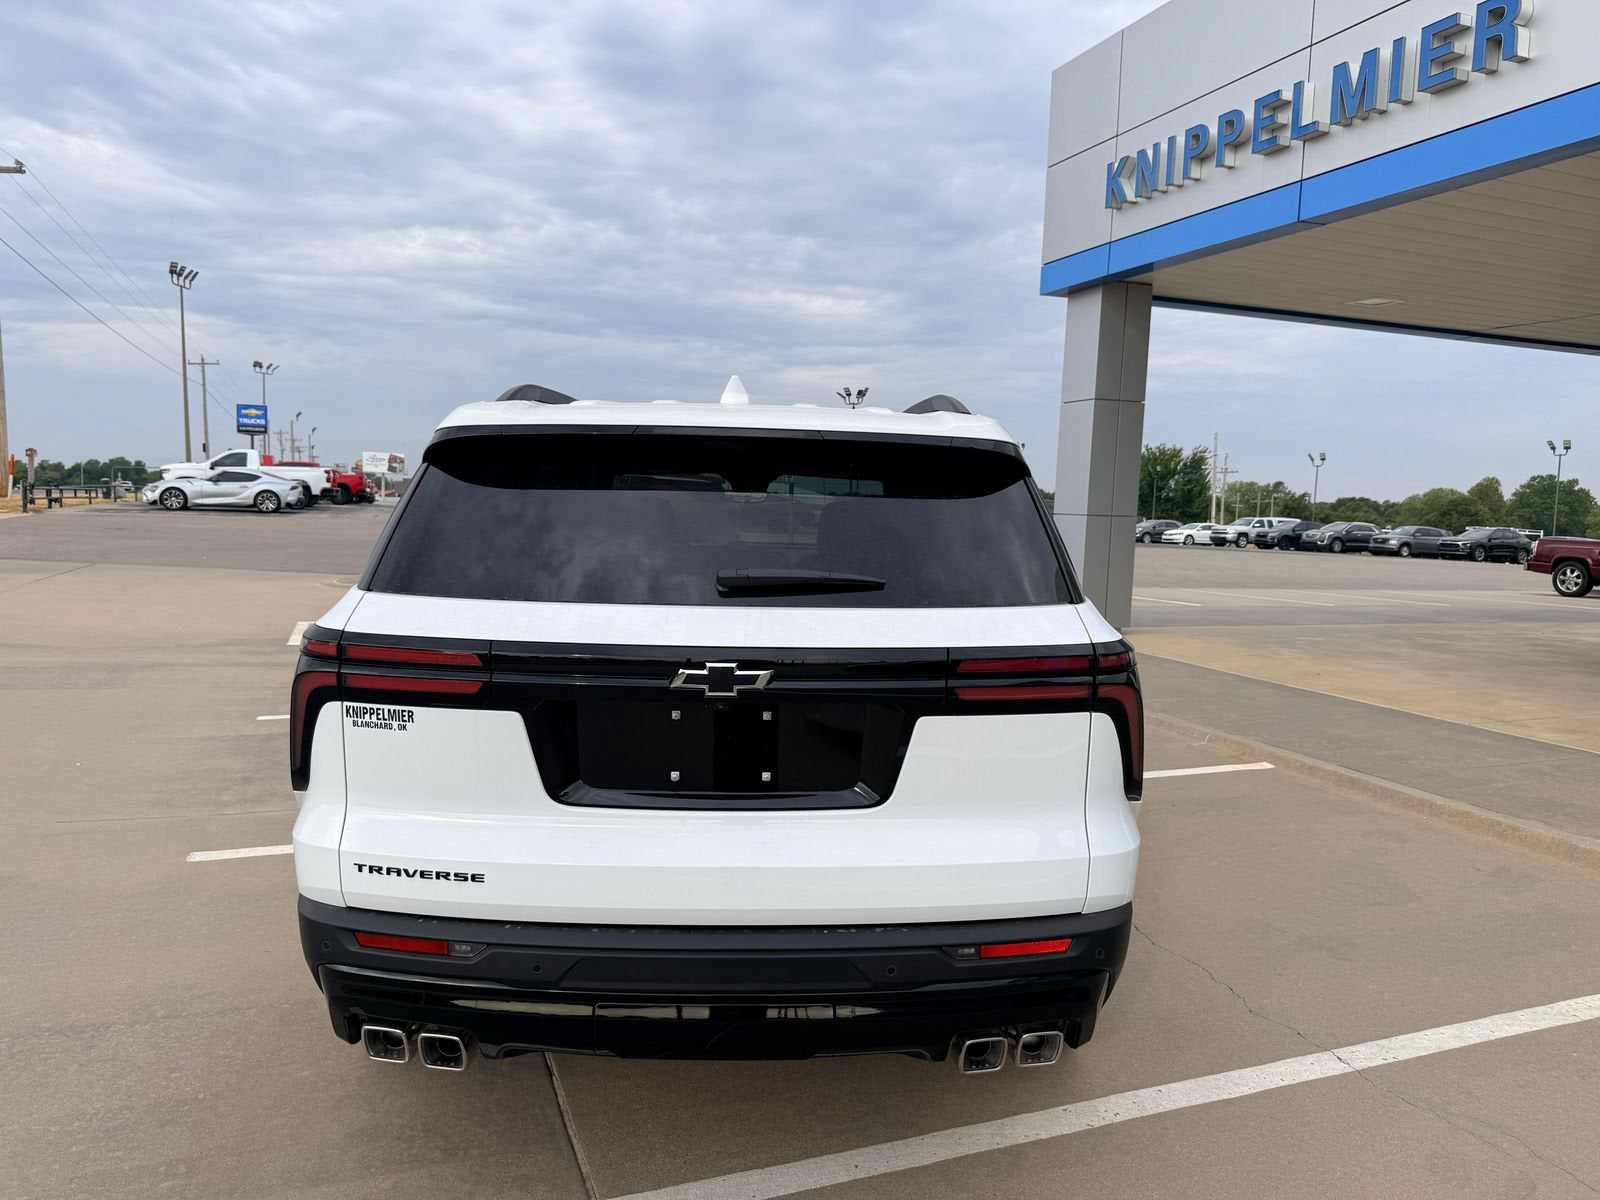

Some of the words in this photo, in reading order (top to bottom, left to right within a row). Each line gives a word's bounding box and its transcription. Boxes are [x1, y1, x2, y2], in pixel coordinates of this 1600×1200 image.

[1105, 0, 1531, 210] KNIPPELMIER
[239, 417, 266, 425] TRUCKS
[345, 704, 415, 724] KNIPPELMIER
[352, 719, 396, 732] BLANCHARD,
[397, 723, 408, 732] OK
[353, 863, 485, 883] TRAVERSE
